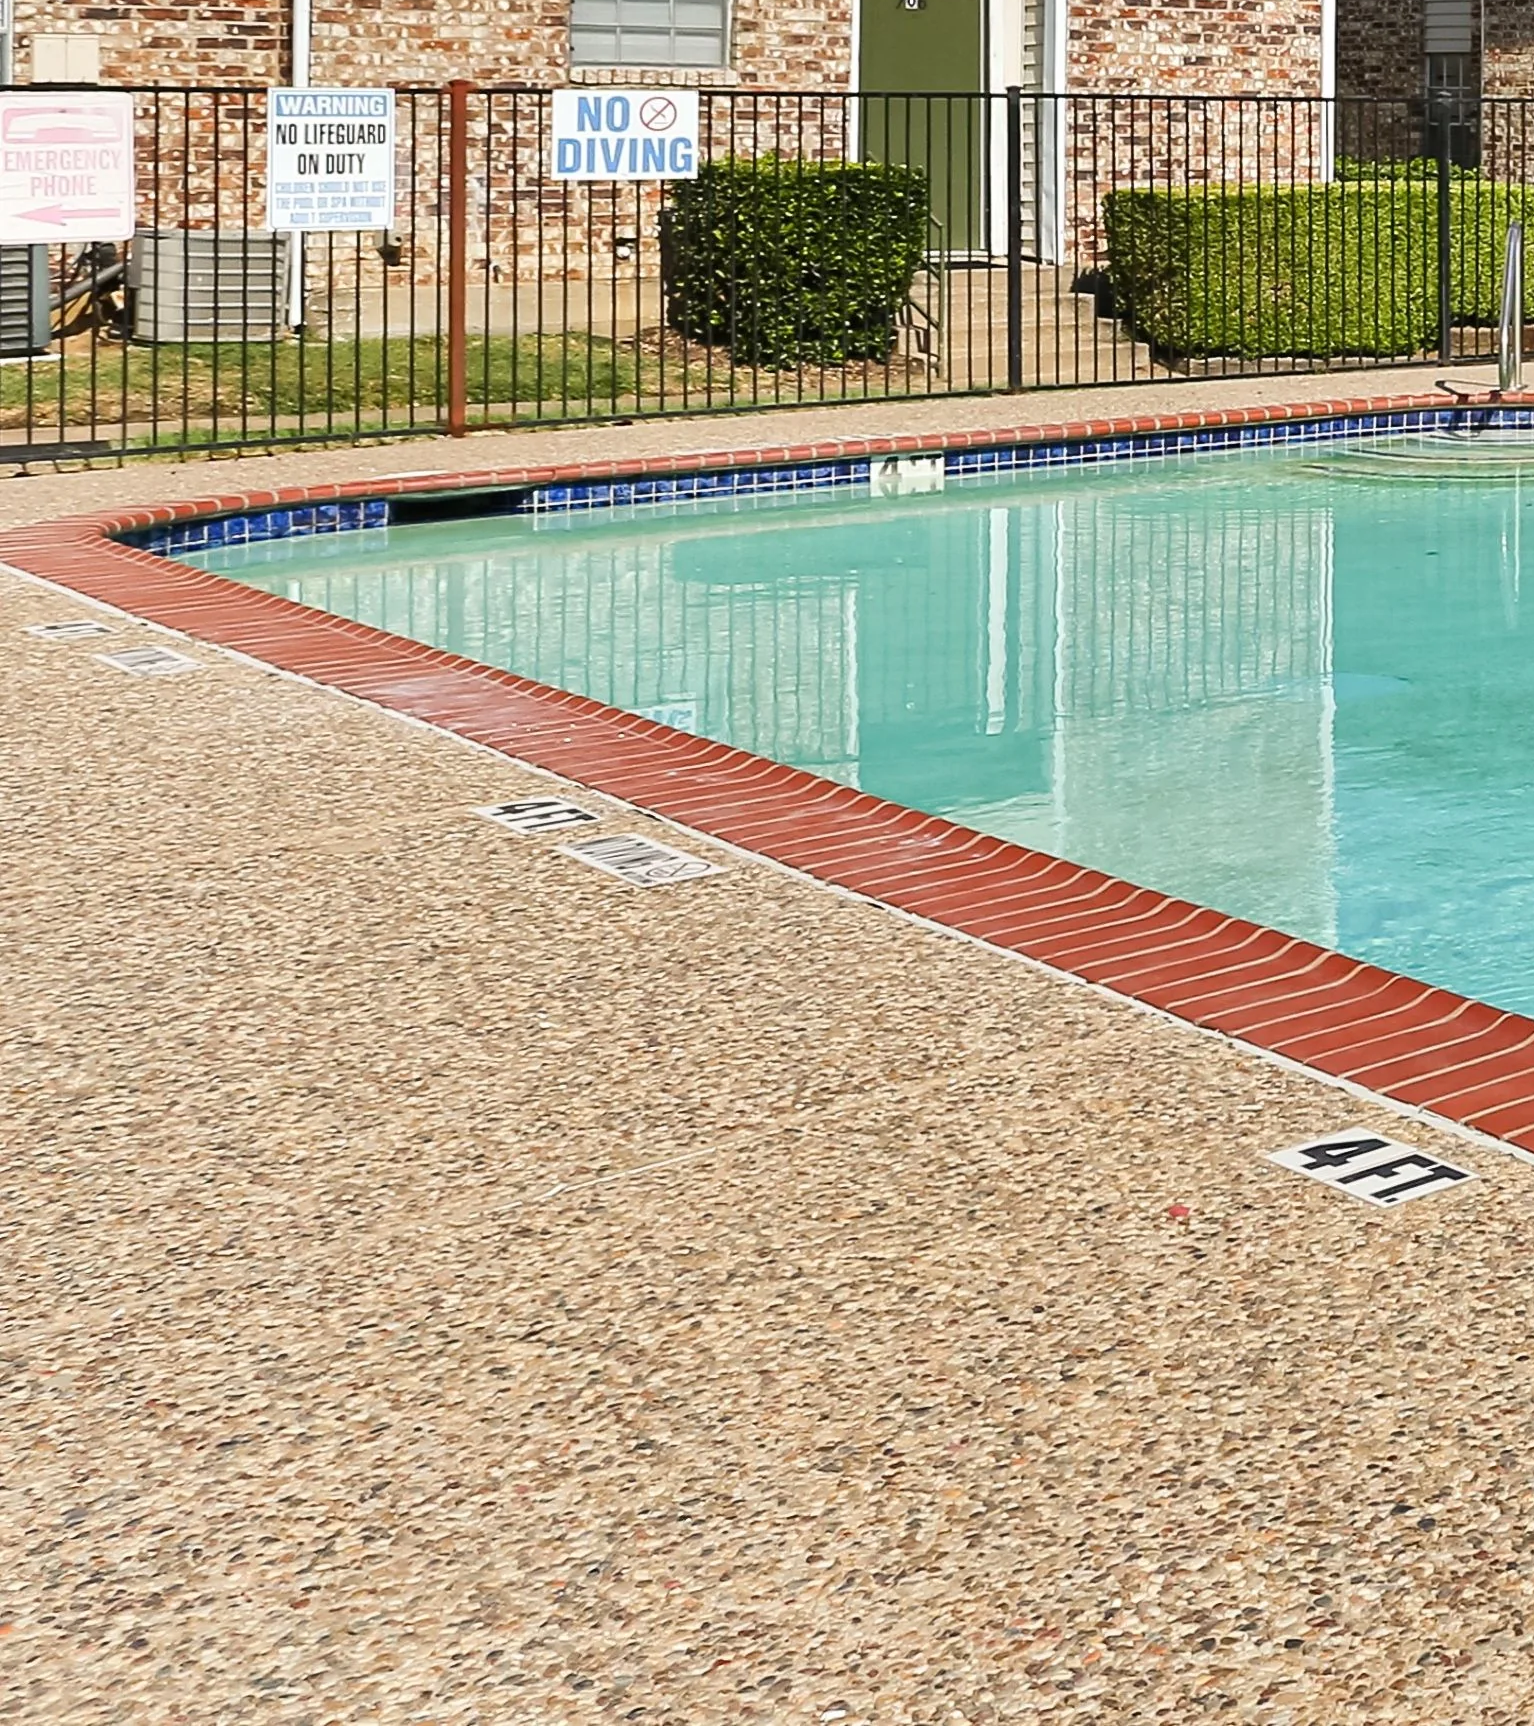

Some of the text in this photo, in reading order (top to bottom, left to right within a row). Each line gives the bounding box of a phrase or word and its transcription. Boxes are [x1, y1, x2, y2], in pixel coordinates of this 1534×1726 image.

[278, 95, 384, 115] WARNING
[577, 96, 630, 132] NO
[276, 123, 386, 145] NO LIFEGUARD
[4, 149, 121, 172] EMERGENCY
[297, 153, 365, 175] ON DUTY
[557, 137, 692, 173] DIVING
[30, 175, 97, 197] PHONE
[491, 801, 598, 830] 4 FT
[1297, 1138, 1393, 1171] 4
